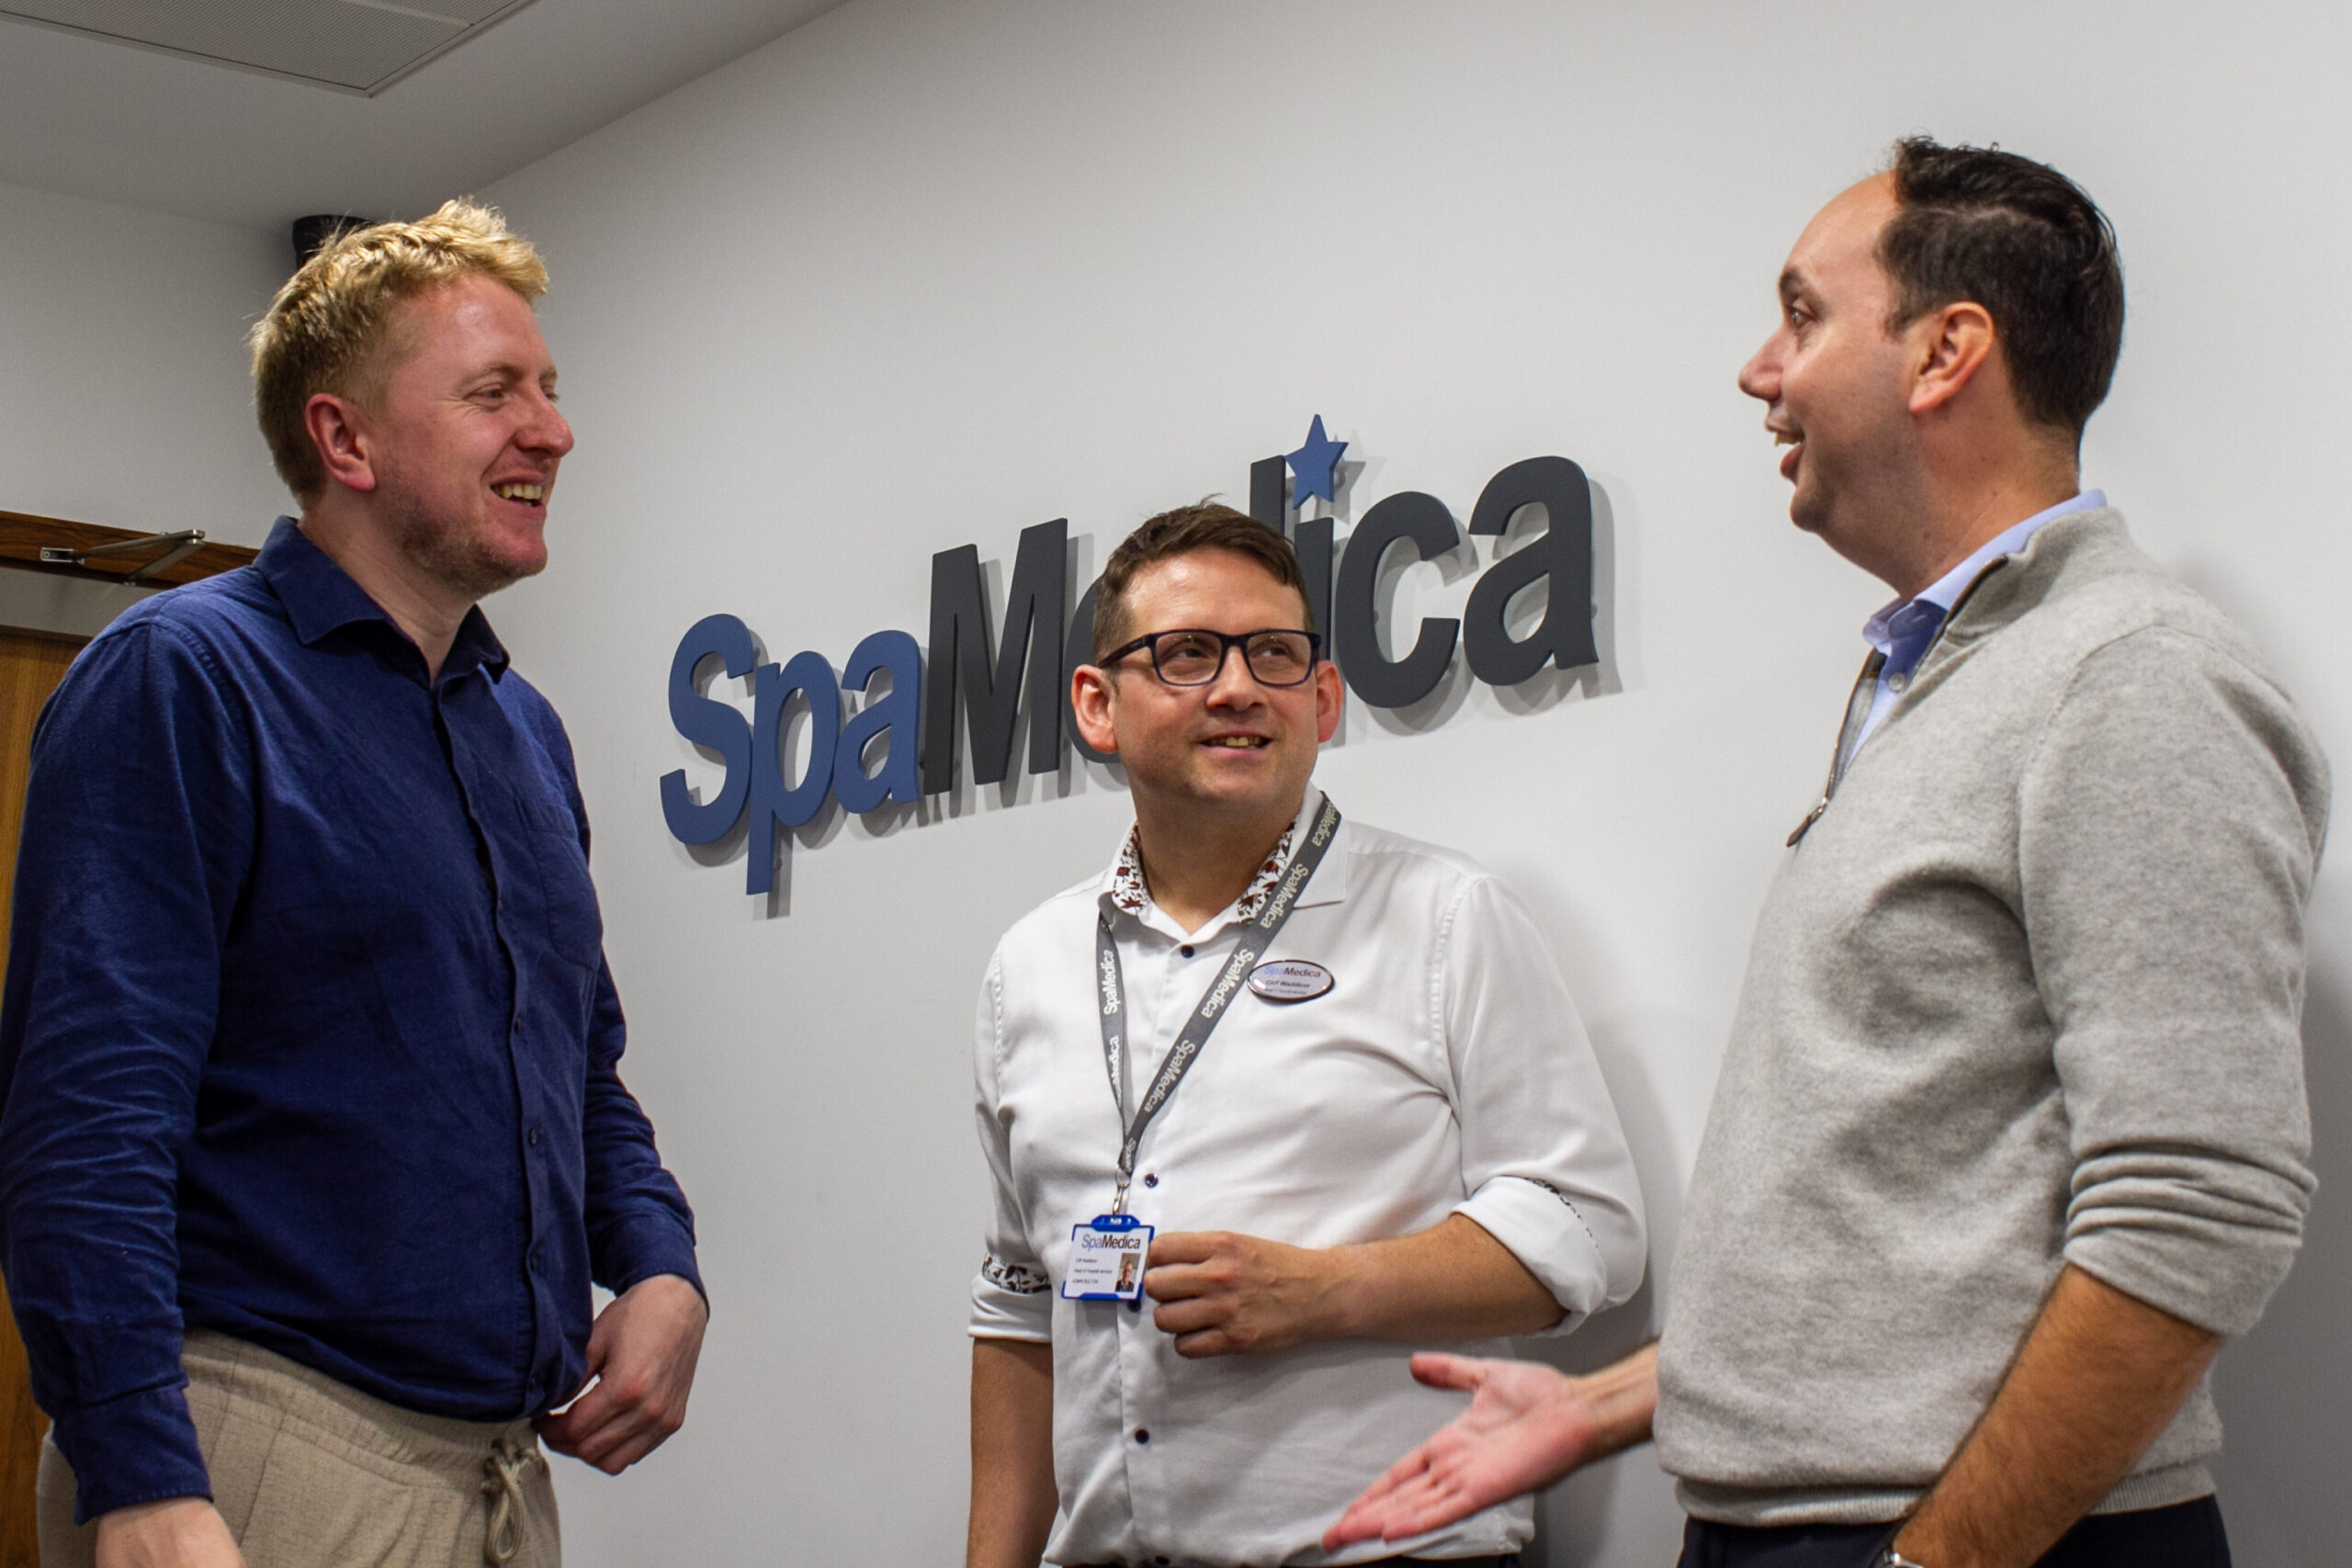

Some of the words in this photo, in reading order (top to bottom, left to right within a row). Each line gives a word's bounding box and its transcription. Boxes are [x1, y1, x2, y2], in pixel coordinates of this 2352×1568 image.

[660, 414, 1600, 895] SpaMica
[1260, 863, 1308, 929] SpaMedica
[1102, 950, 1121, 1015] SpaMedica
[1201, 948, 1255, 1019] SpaMedica
[1264, 965, 1321, 978] SpaMedica
[1144, 1039, 1195, 1113] SpaMedica
[1081, 1234, 1141, 1251] SpaMedica
